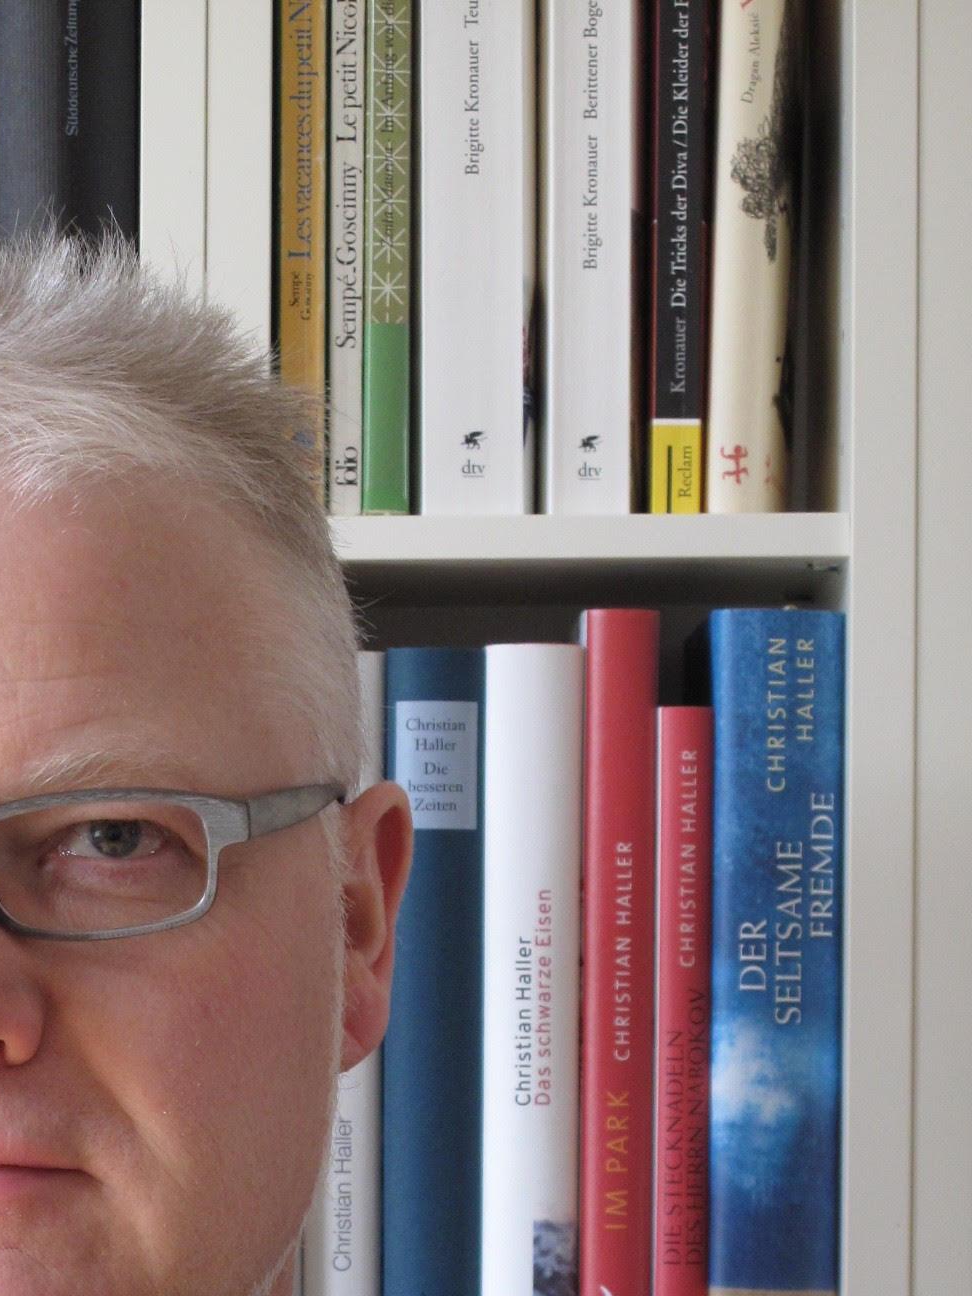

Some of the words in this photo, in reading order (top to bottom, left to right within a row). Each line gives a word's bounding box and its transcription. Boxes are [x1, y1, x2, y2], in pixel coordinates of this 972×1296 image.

[464, 0, 480, 28] Teu
[672, 12, 690, 38] der
[289, 28, 319, 79] petit
[464, 40, 480, 112] Kronauer
[583, 44, 599, 119] Berittener
[672, 43, 690, 101] Kleider
[65, 48, 79, 136] Süddeutsche
[289, 81, 313, 110] du
[336, 61, 362, 108] petit
[336, 113, 358, 143] Le
[464, 118, 484, 175] Brigitte
[671, 106, 689, 134] Die
[295, 115, 313, 213] vacances
[583, 135, 599, 207] Kronauer
[671, 152, 688, 190] Diva
[670, 195, 688, 221] der
[287, 217, 313, 260] Les
[583, 212, 603, 270] Brigitte
[669, 225, 688, 275] Tricks
[670, 278, 688, 308] Die
[669, 316, 687, 393] Kronauer
[335, 446, 359, 487] folio
[461, 458, 486, 476] dtv
[577, 461, 603, 478] dtv
[677, 445, 693, 498] Reclam
[767, 637, 787, 793] CHRISTIAN
[796, 637, 815, 742] HALLER
[405, 717, 466, 732] Christian
[414, 737, 459, 752] Haller
[407, 780, 464, 794] besseren
[424, 761, 449, 776] Die
[680, 749, 698, 833] HALLER
[413, 798, 459, 812] Zeiten
[615, 841, 633, 925] HALLER
[810, 792, 836, 938] FREMDE
[535, 889, 552, 948] Eisen
[679, 843, 697, 968] CHRISTIAN
[774, 840, 804, 1025] SELTSAME
[515, 936, 532, 1001] Haller
[739, 918, 768, 991] DER
[534, 956, 552, 1057] schwarze
[612, 936, 632, 1062] CHRISTIAN
[514, 1008, 532, 1107] Christian
[534, 1066, 551, 1107] Das
[333, 1116, 354, 1174] Haller
[606, 1090, 630, 1172] PARK
[663, 1030, 685, 1217] STECKNADELN
[331, 1182, 353, 1272] Christian
[604, 1189, 628, 1231] IM
[663, 1224, 682, 1266] DIE
